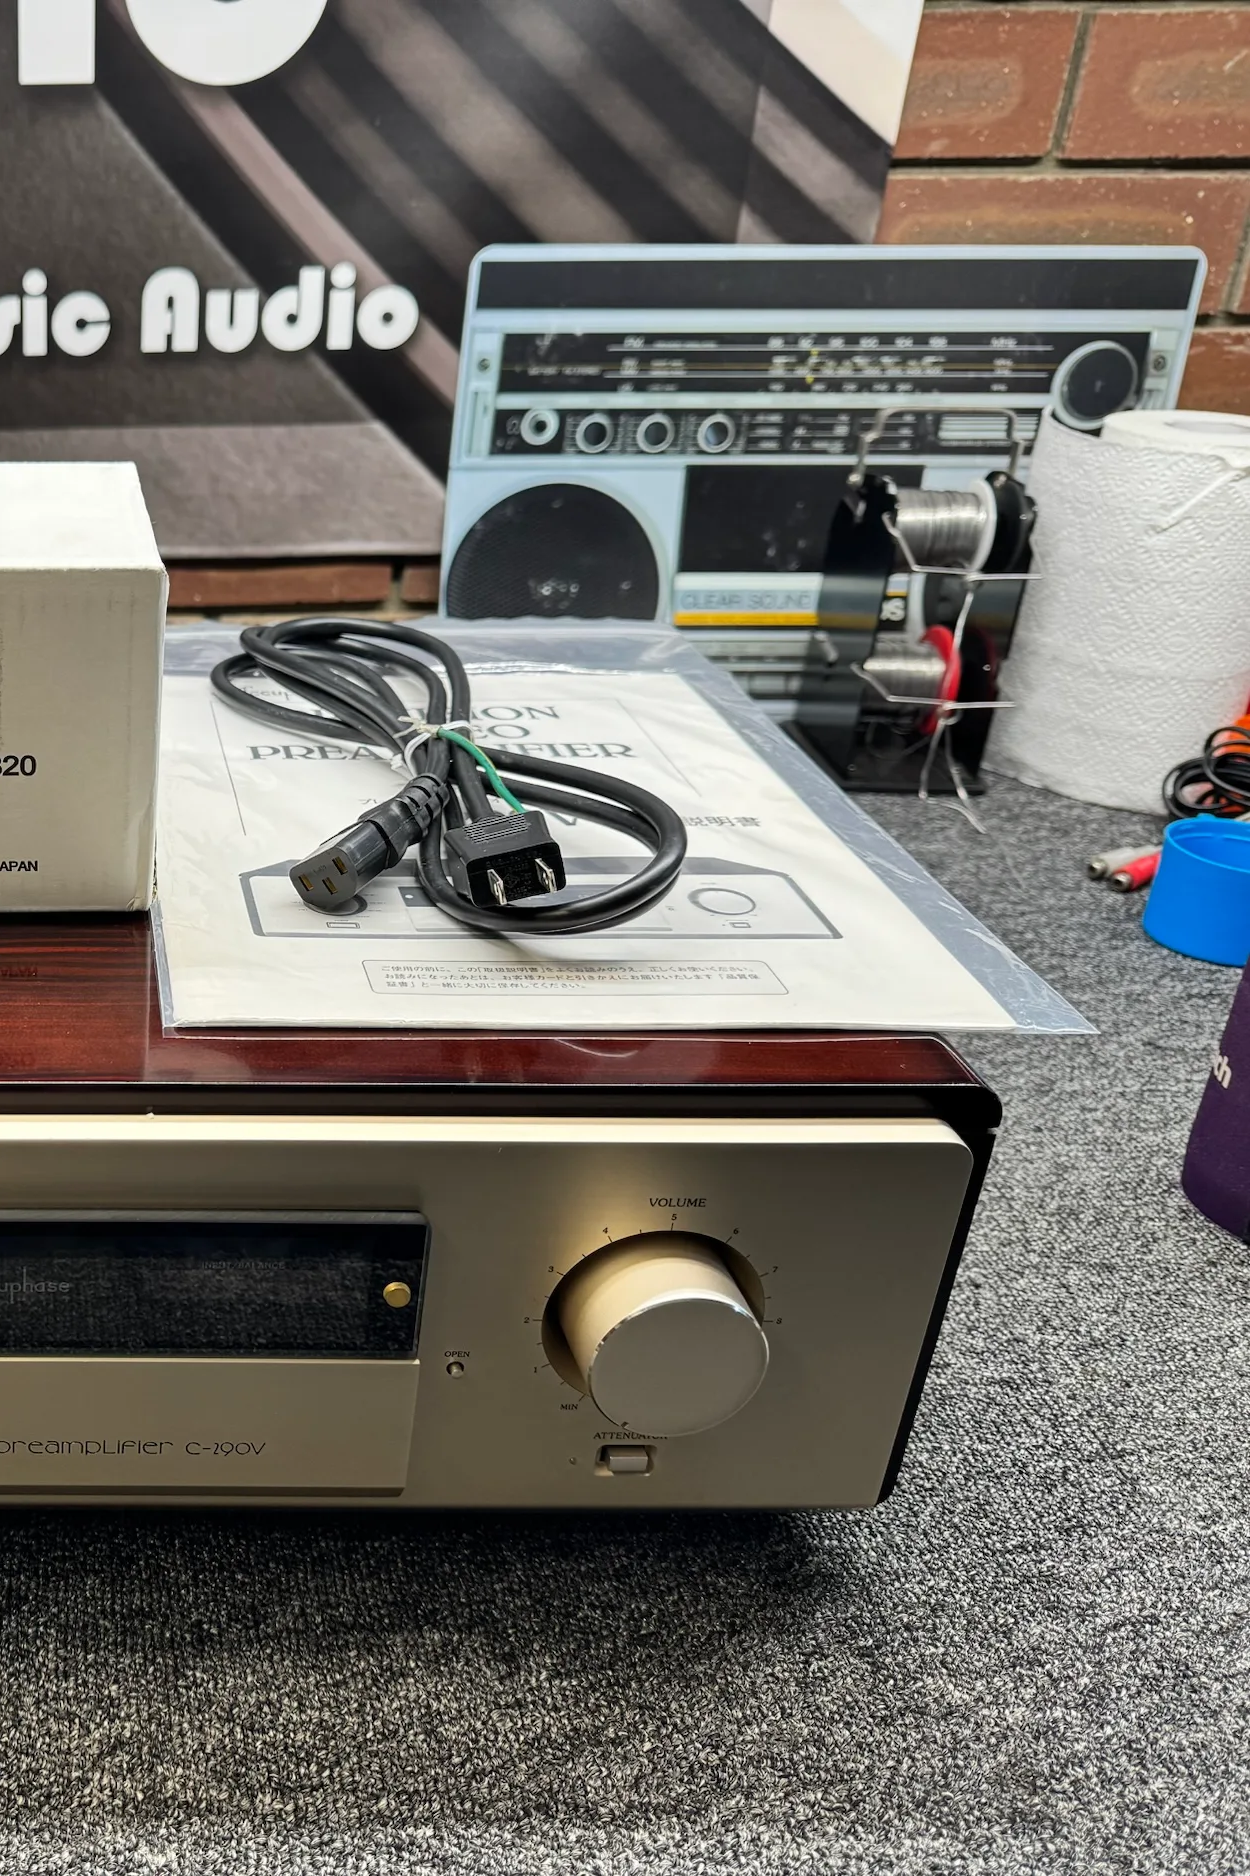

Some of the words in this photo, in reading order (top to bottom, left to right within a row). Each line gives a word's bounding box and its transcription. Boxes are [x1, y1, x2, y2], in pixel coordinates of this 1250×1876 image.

[140, 261, 419, 354] Audio
[649, 1198, 707, 1208] VOLUME
[444, 1350, 470, 1358] OPEN
